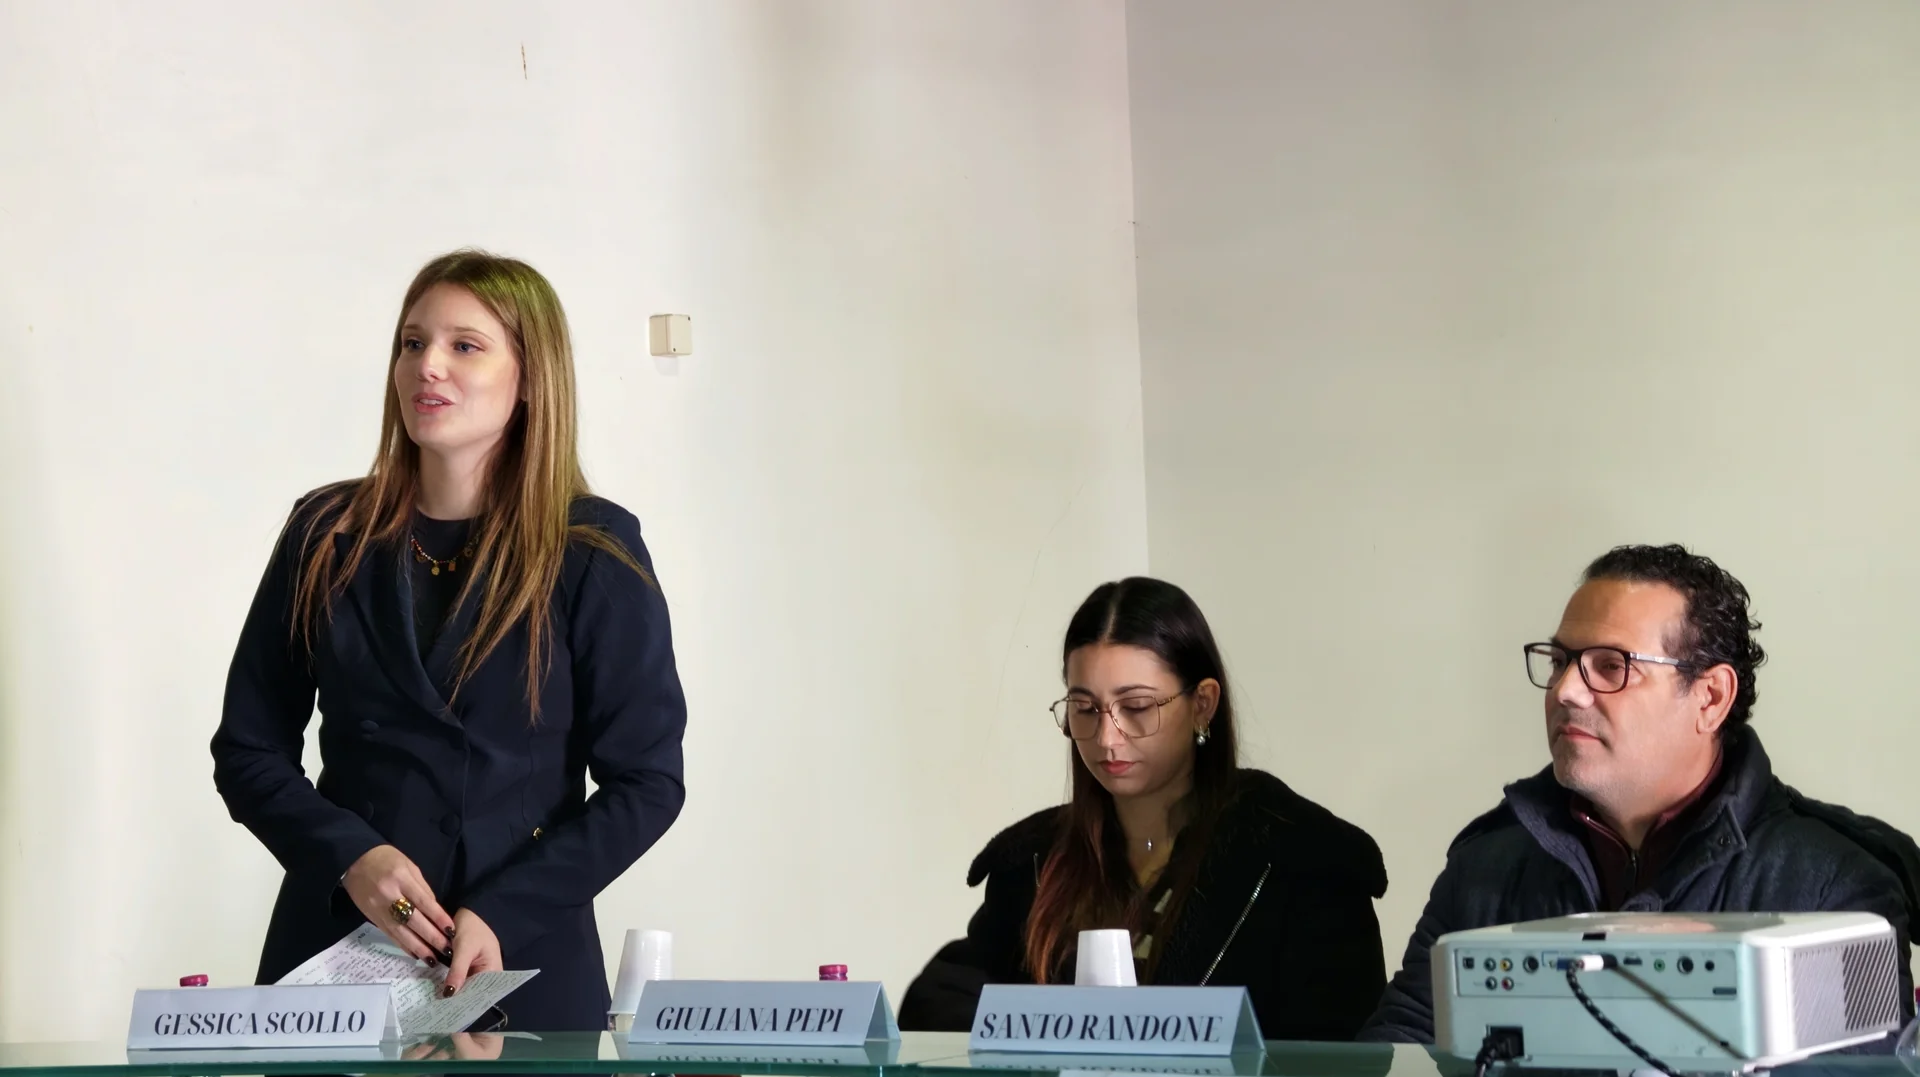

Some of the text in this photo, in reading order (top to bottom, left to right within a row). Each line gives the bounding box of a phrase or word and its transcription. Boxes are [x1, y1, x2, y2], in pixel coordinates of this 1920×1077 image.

[154, 1009, 366, 1035] GESSICA SCOLLO
[656, 1006, 844, 1032] GIULIANA PEPI
[980, 1012, 1223, 1042] SANTO RANDONE
